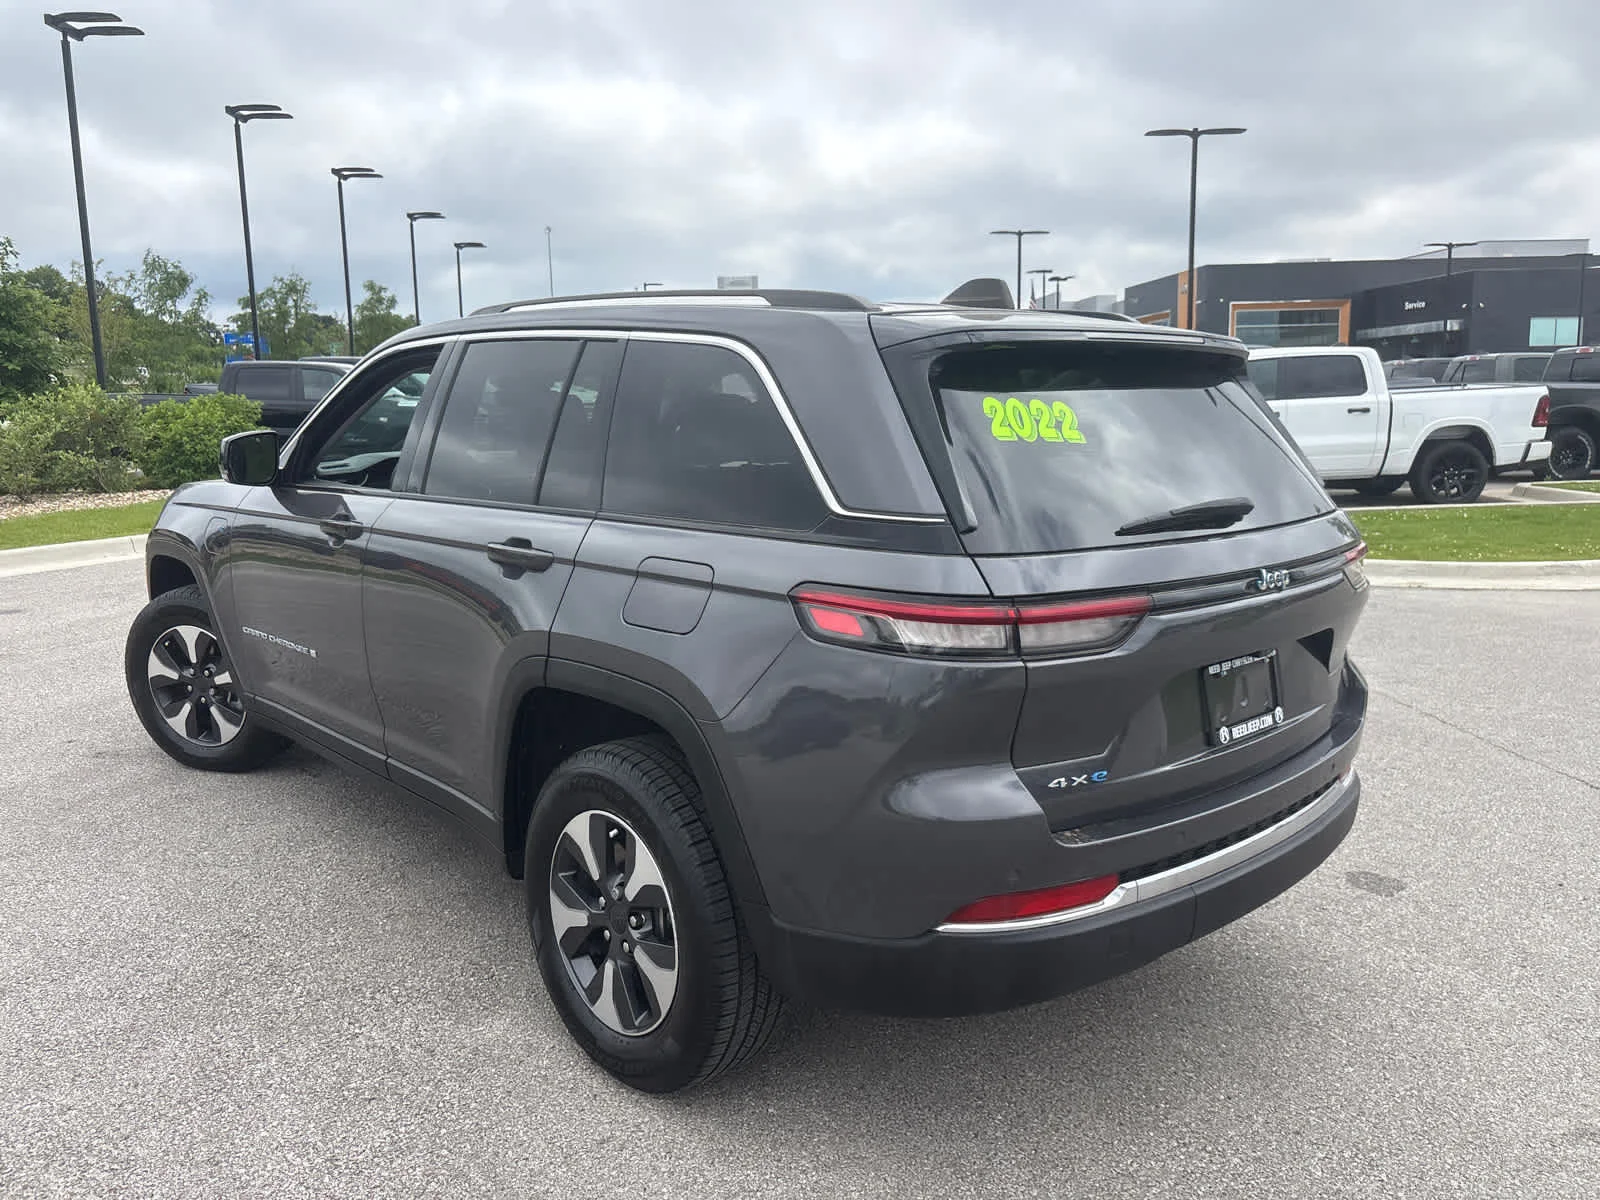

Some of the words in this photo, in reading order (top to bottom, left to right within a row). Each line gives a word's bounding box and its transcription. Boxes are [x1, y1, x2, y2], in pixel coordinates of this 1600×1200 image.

[1404, 300, 1426, 310] Service
[982, 396, 1087, 443] 2022
[1257, 568, 1290, 590] Jeep
[242, 626, 268, 640] GRAND
[268, 634, 309, 655] CHEROKEE
